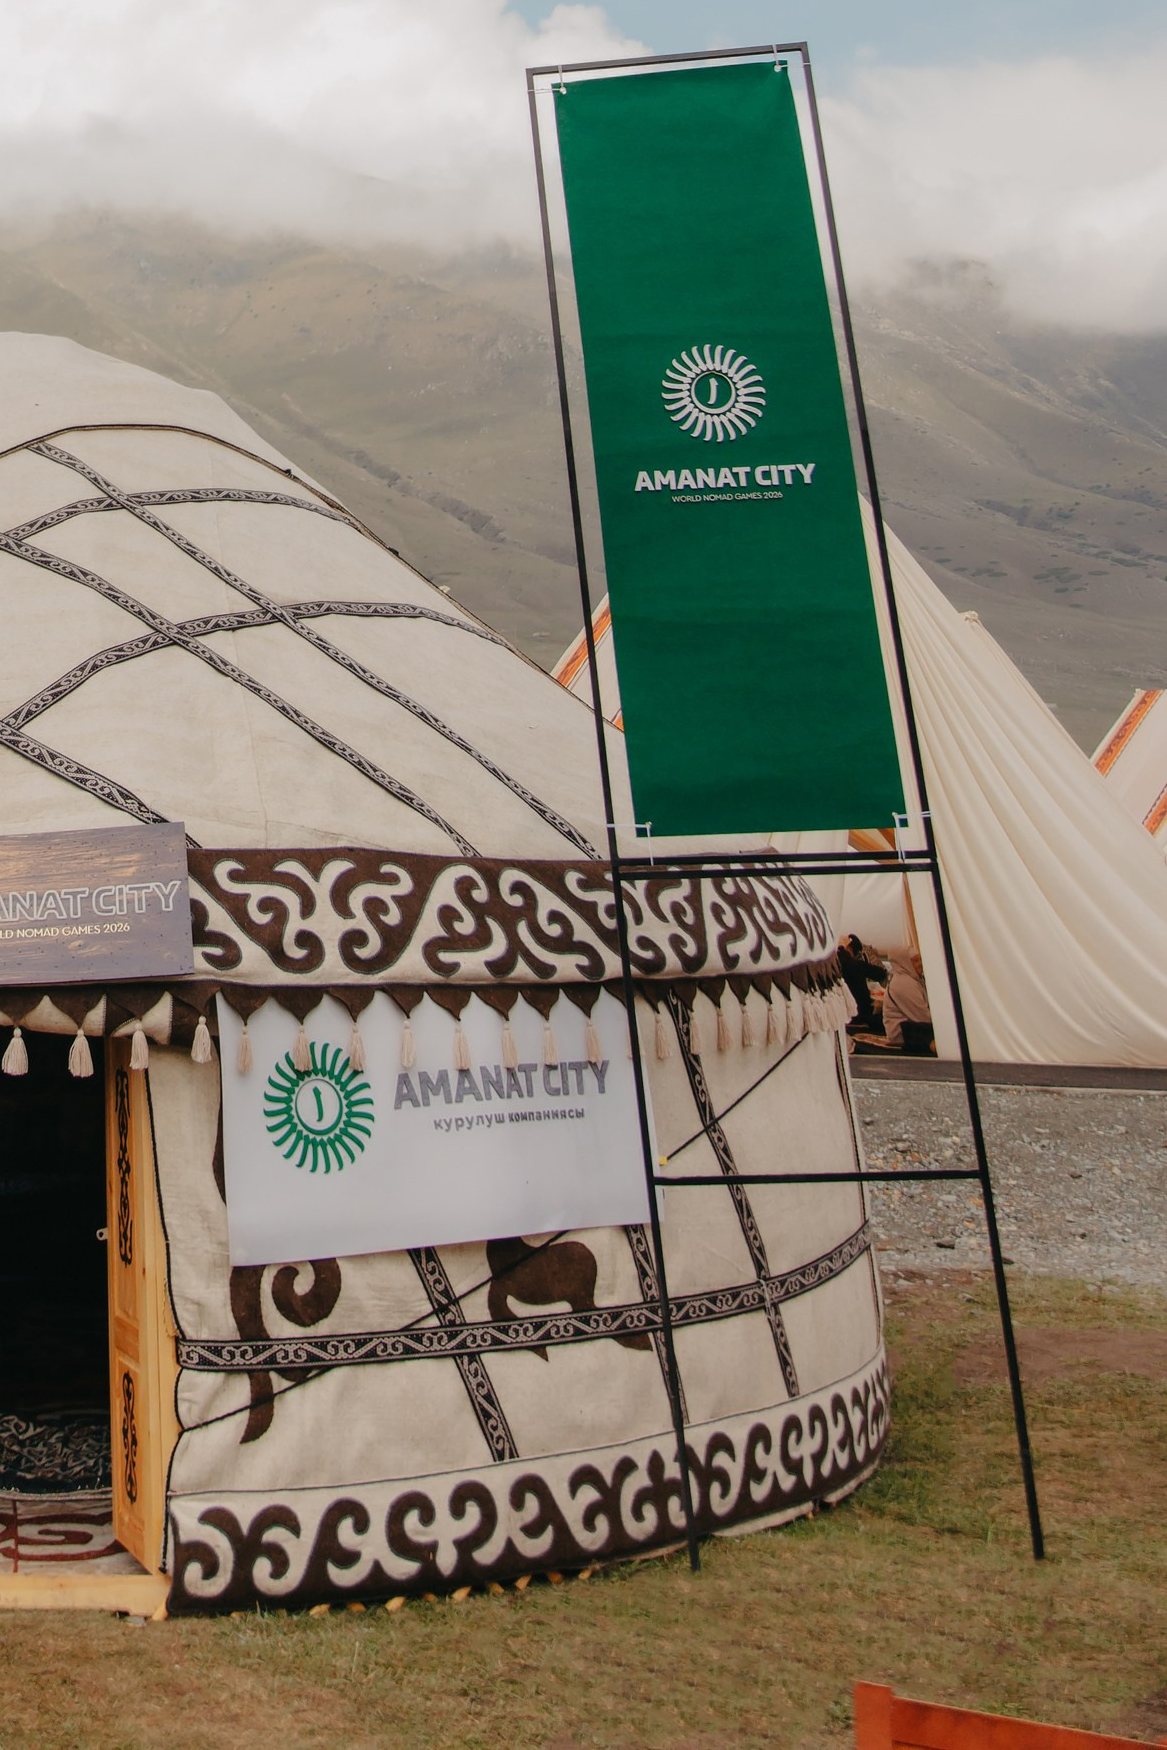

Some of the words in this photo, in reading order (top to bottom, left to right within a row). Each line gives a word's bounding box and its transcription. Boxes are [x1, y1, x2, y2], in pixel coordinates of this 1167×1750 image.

[634, 466, 751, 492] AMANAT
[754, 463, 816, 486] CITY
[672, 494, 702, 503] WORLD
[703, 493, 734, 502] NOMAD
[734, 492, 762, 500] GAMES
[763, 491, 783, 499] 2026
[92, 880, 182, 916] CITY
[16, 927, 60, 938] NOMAD
[62, 924, 101, 937] GAMES
[103, 922, 131, 934] 2026
[393, 1063, 538, 1110] AMANAT
[542, 1060, 610, 1097] CITY
[433, 1112, 505, 1132] курулуш
[508, 1107, 586, 1123] компаниясы
